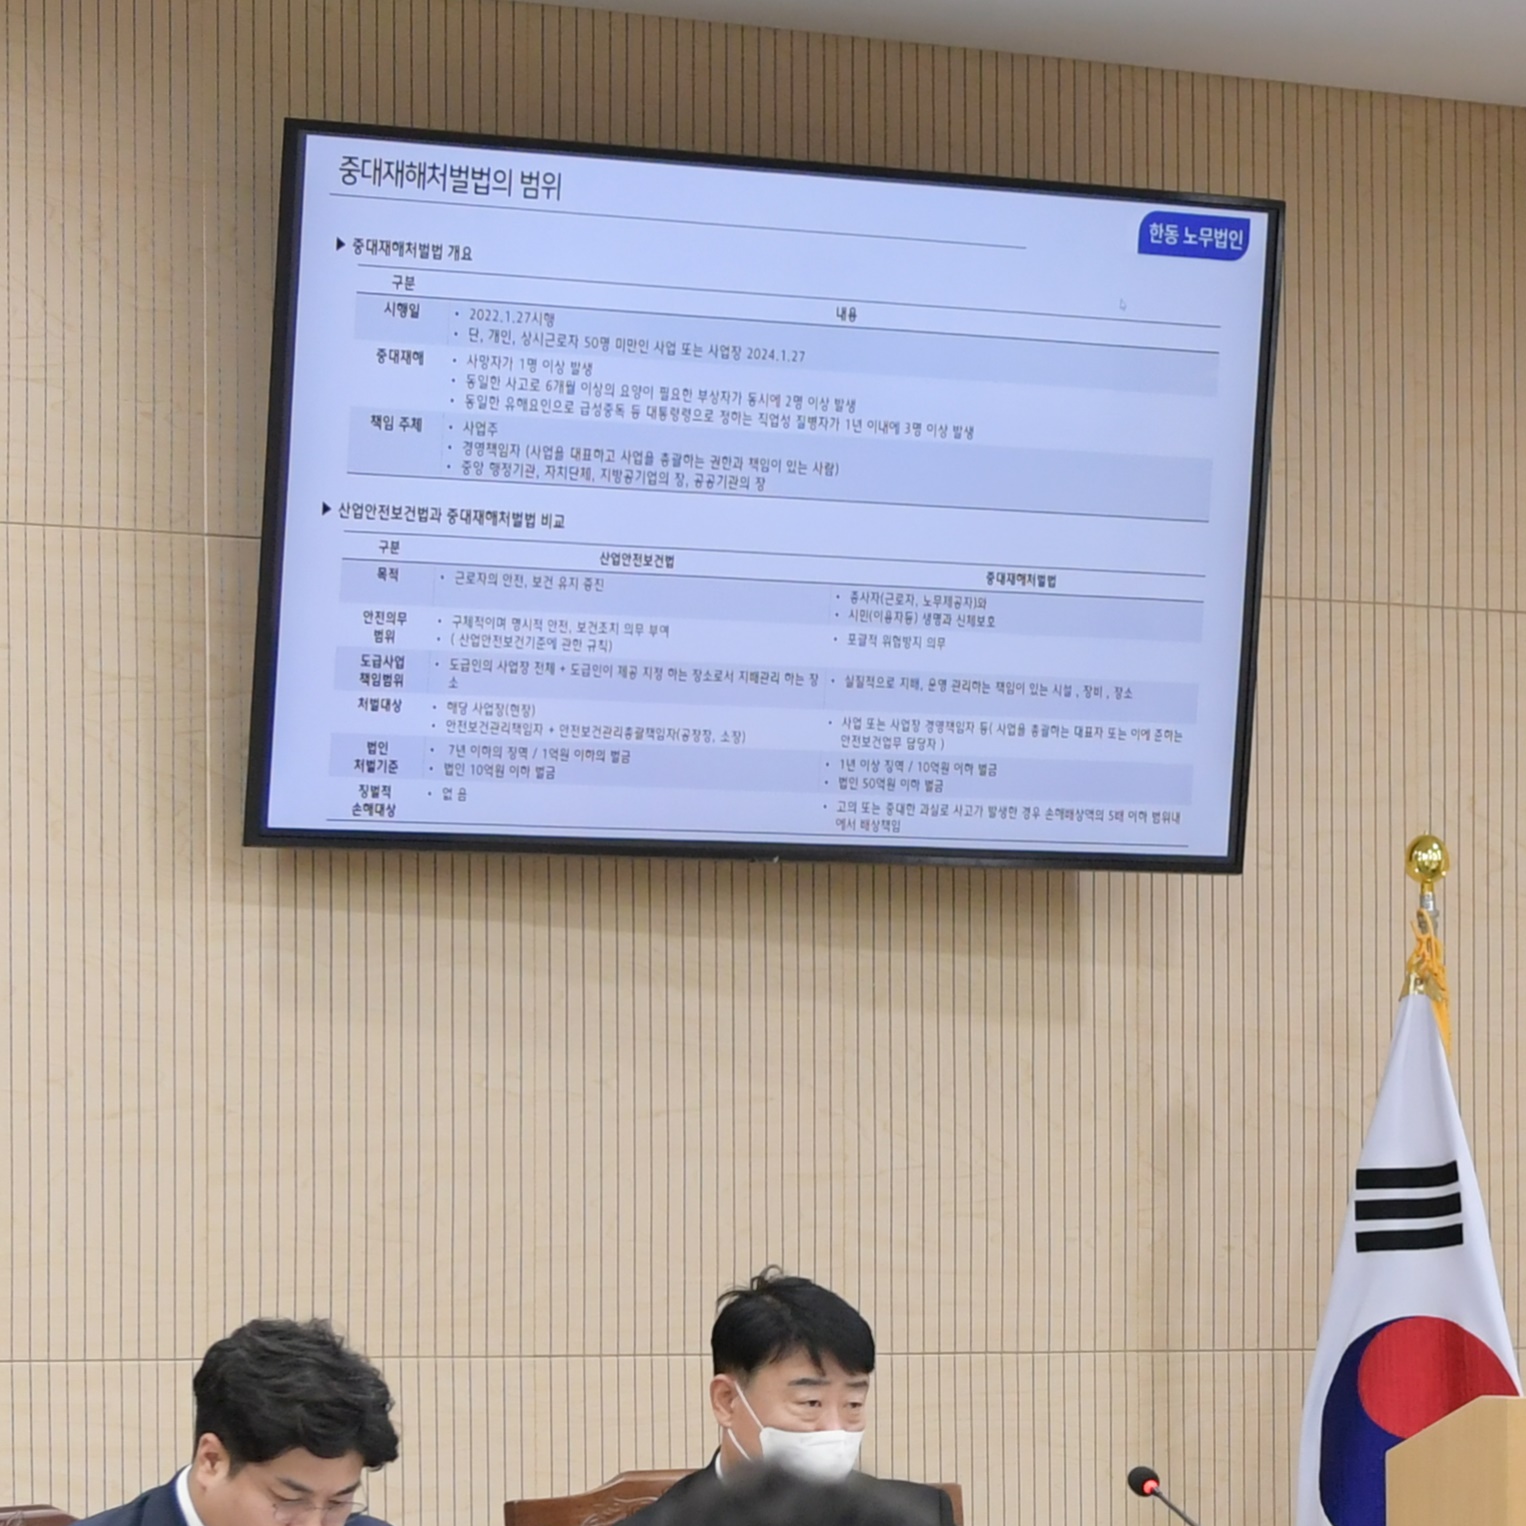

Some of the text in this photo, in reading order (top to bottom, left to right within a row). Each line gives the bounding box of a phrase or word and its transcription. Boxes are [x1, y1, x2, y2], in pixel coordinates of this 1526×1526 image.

[338, 155, 562, 202] 중대재해처벌법의 범위
[1148, 222, 1244, 251] 한동 노무법인
[352, 237, 473, 262] 중대재해처벌법 개요
[391, 274, 416, 292] 구분
[383, 301, 420, 319] 시행일
[469, 307, 556, 328] 2022.1.27시행
[836, 306, 858, 323] 내용
[488, 328, 516, 346] 개인,
[520, 330, 580, 350] 상시근로자
[584, 335, 611, 353] 50명
[615, 337, 649, 355] 미만인
[653, 340, 677, 357] 사업
[680, 342, 704, 359] 또는
[707, 343, 742, 362] 사업장
[746, 346, 806, 363] 2024.1.27
[376, 347, 425, 366] 중대재해
[466, 353, 593, 378] 사망자가 1명 이상 발생
[465, 373, 857, 415] 동일한 사고로 6개월 이상의 요양이 필요한 부상자가 동시에 2명 이상 발생
[370, 414, 423, 433] 책임 주체
[464, 393, 500, 412] 동일한
[504, 395, 574, 415] 유해요인으로
[579, 400, 625, 419] 급성중독
[630, 403, 641, 420] 등
[719, 409, 753, 427] 정하는
[758, 412, 791, 430] 직업성
[796, 414, 840, 432] 질병자가
[845, 418, 863, 434] 1년
[866, 419, 901, 436] 이내에
[904, 421, 923, 438] 3명
[926, 423, 949, 439] 이상
[952, 424, 975, 441] 발생
[462, 420, 498, 438] 사업주
[462, 440, 521, 459] 경영책임자
[525, 444, 565, 462] (사업을
[569, 446, 616, 464] 대표하고
[620, 449, 655, 467] 사업을
[709, 454, 744, 472] 권한과
[748, 456, 782, 474] 책임이
[785, 459, 808, 476] 있는
[812, 461, 840, 477] 사람)
[461, 459, 485, 477] 중앙
[488, 461, 540, 480] 행정기관,
[544, 464, 595, 483] 자치단체,
[599, 467, 670, 487] 지방공기업의
[674, 471, 689, 489] 장,
[693, 472, 751, 491] 공공기관의
[338, 502, 565, 529] 산업안전보건법과 중대재해처벌법 비교
[378, 539, 400, 556] 구분
[599, 551, 675, 569] 산업안전보건법
[377, 566, 399, 582] 목적
[455, 570, 499, 587] 근로자의
[502, 573, 528, 589] 안전,
[532, 575, 554, 590] 보건
[557, 575, 579, 591] 유지
[985, 570, 1057, 589] 중대재해처벌법
[373, 628, 396, 644] 범위
[360, 653, 405, 670] 도급사업
[359, 671, 404, 688] 책임범위
[357, 697, 403, 714] 처벌대상
[354, 758, 399, 775] 처벌기준
